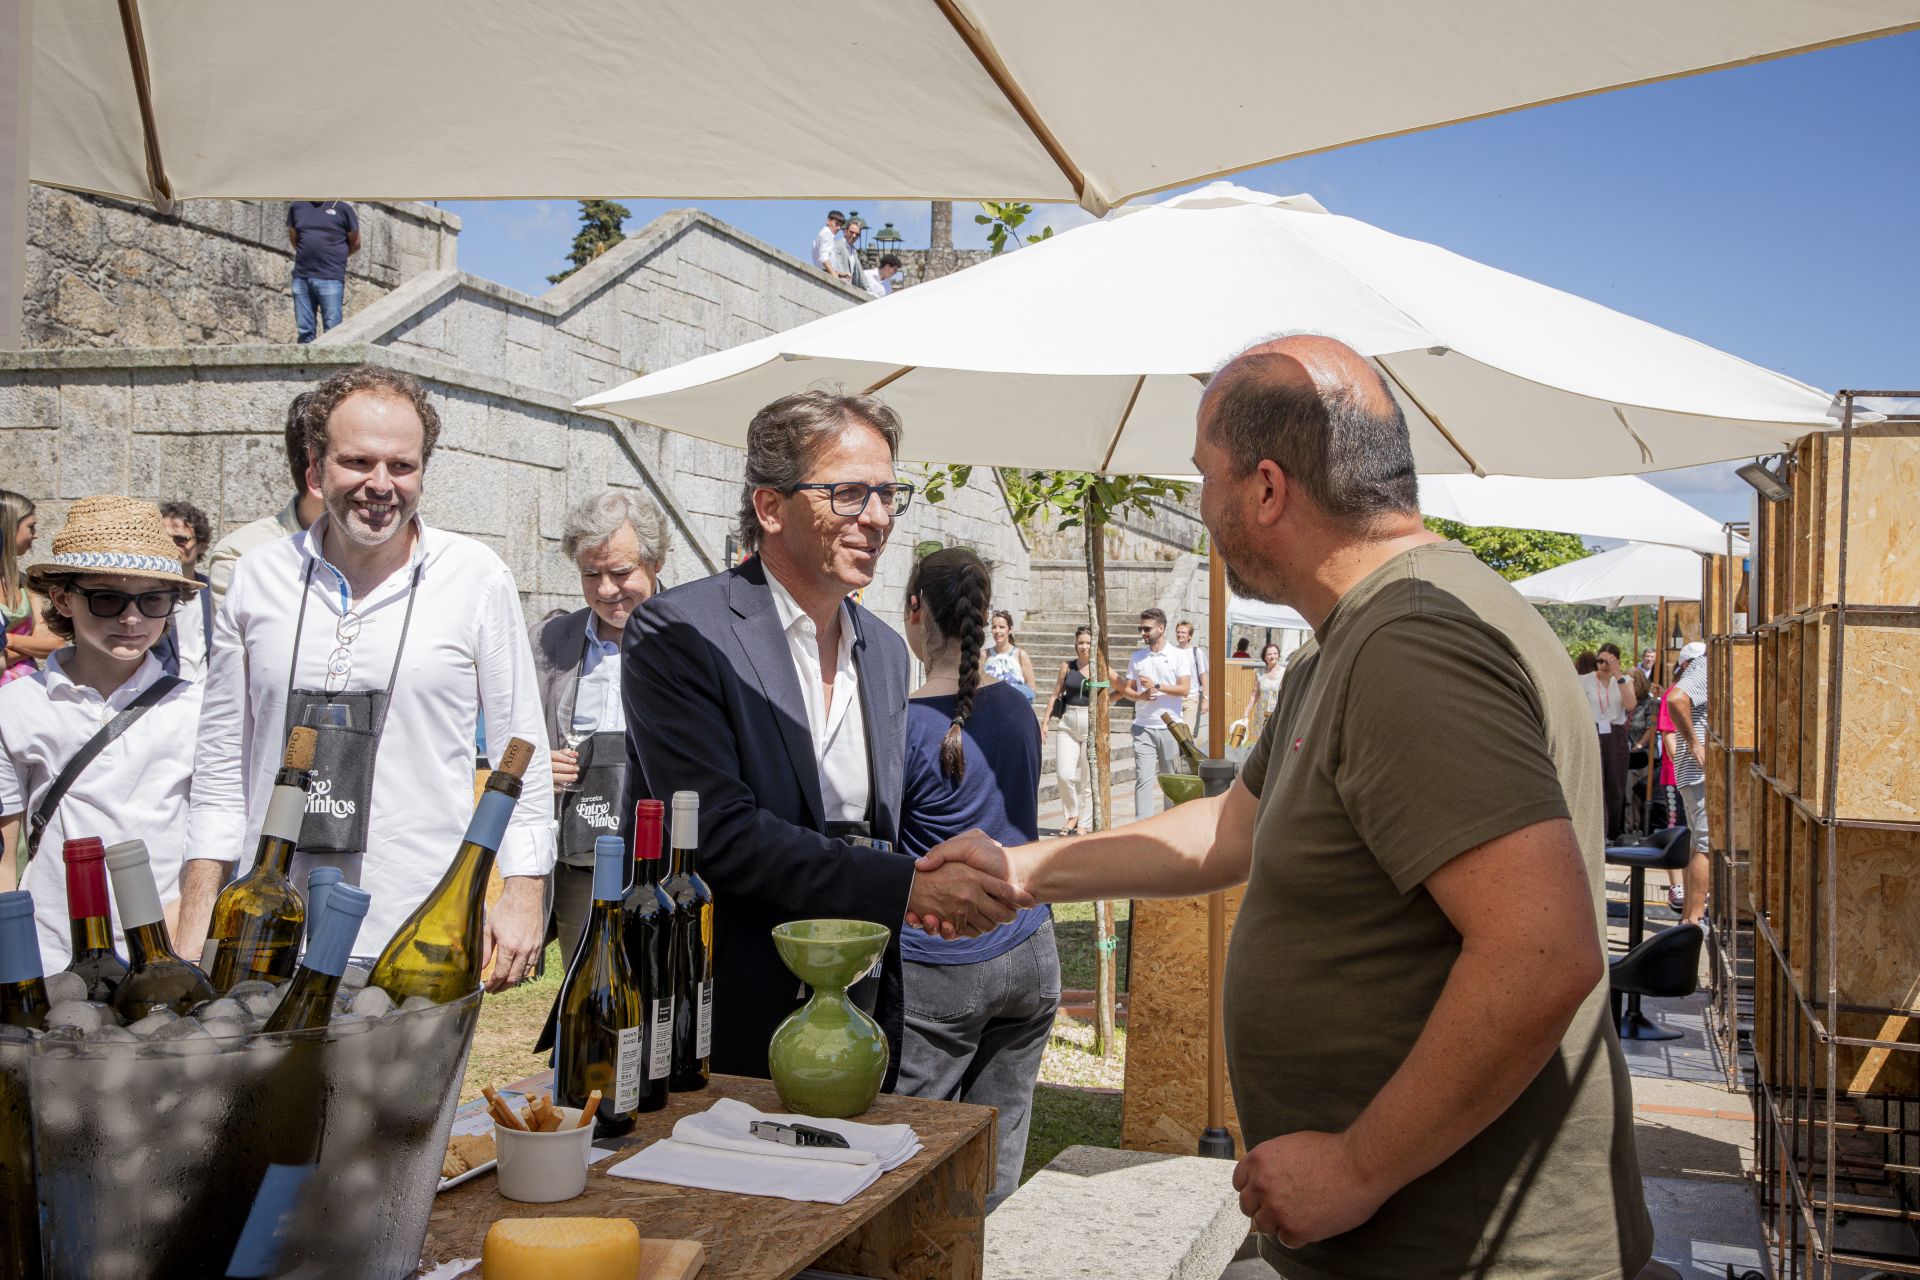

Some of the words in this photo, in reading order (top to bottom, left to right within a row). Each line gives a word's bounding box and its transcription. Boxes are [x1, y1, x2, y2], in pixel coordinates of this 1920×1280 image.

[286, 732, 300, 765] Quint
[576, 801, 610, 819] Entre
[587, 812, 620, 830] Vinho
